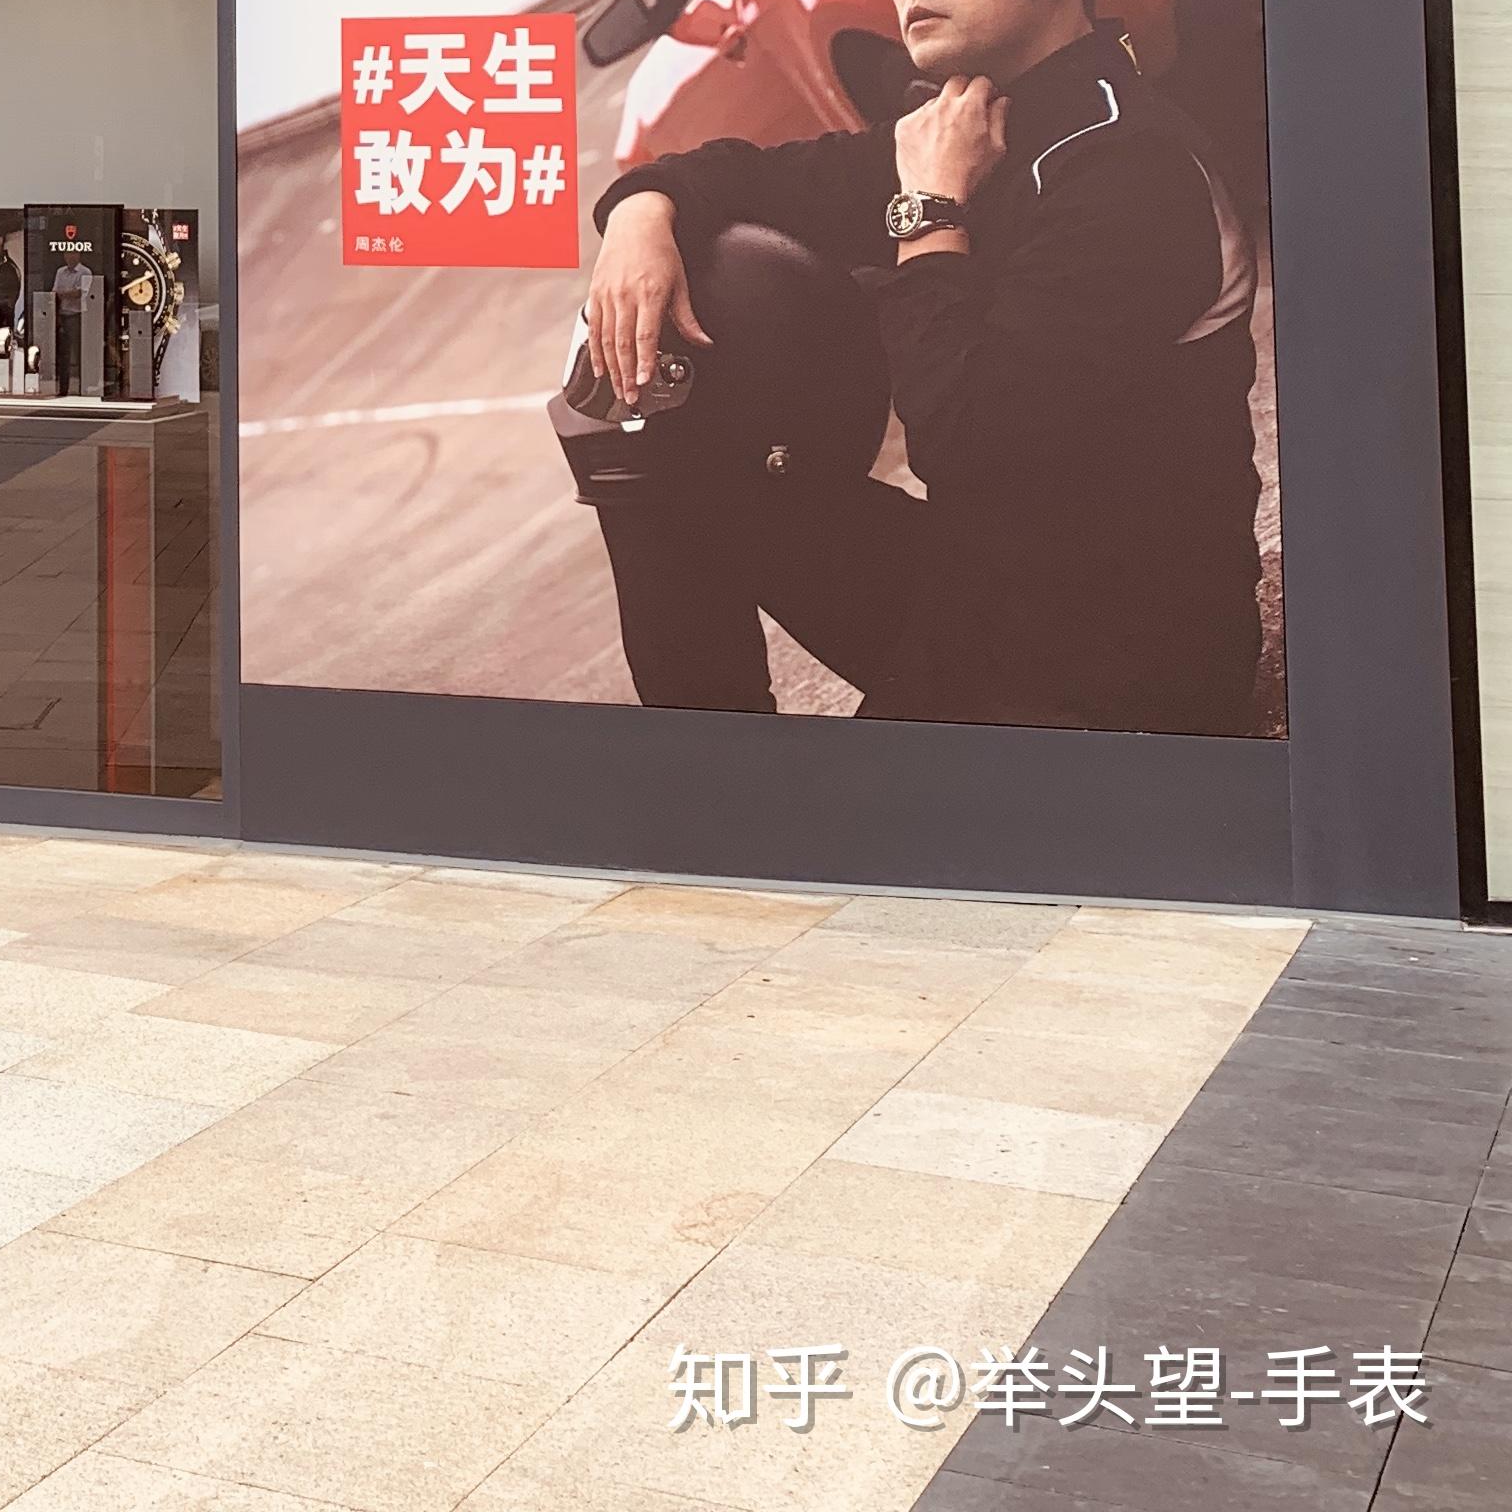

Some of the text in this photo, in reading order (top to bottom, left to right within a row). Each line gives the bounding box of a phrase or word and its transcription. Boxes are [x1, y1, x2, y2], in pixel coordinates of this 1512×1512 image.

[352, 27, 563, 116] #天生
[353, 127, 566, 216] 敢为#
[49, 241, 93, 252] TUDOR
[354, 236, 405, 253] 周杰伦
